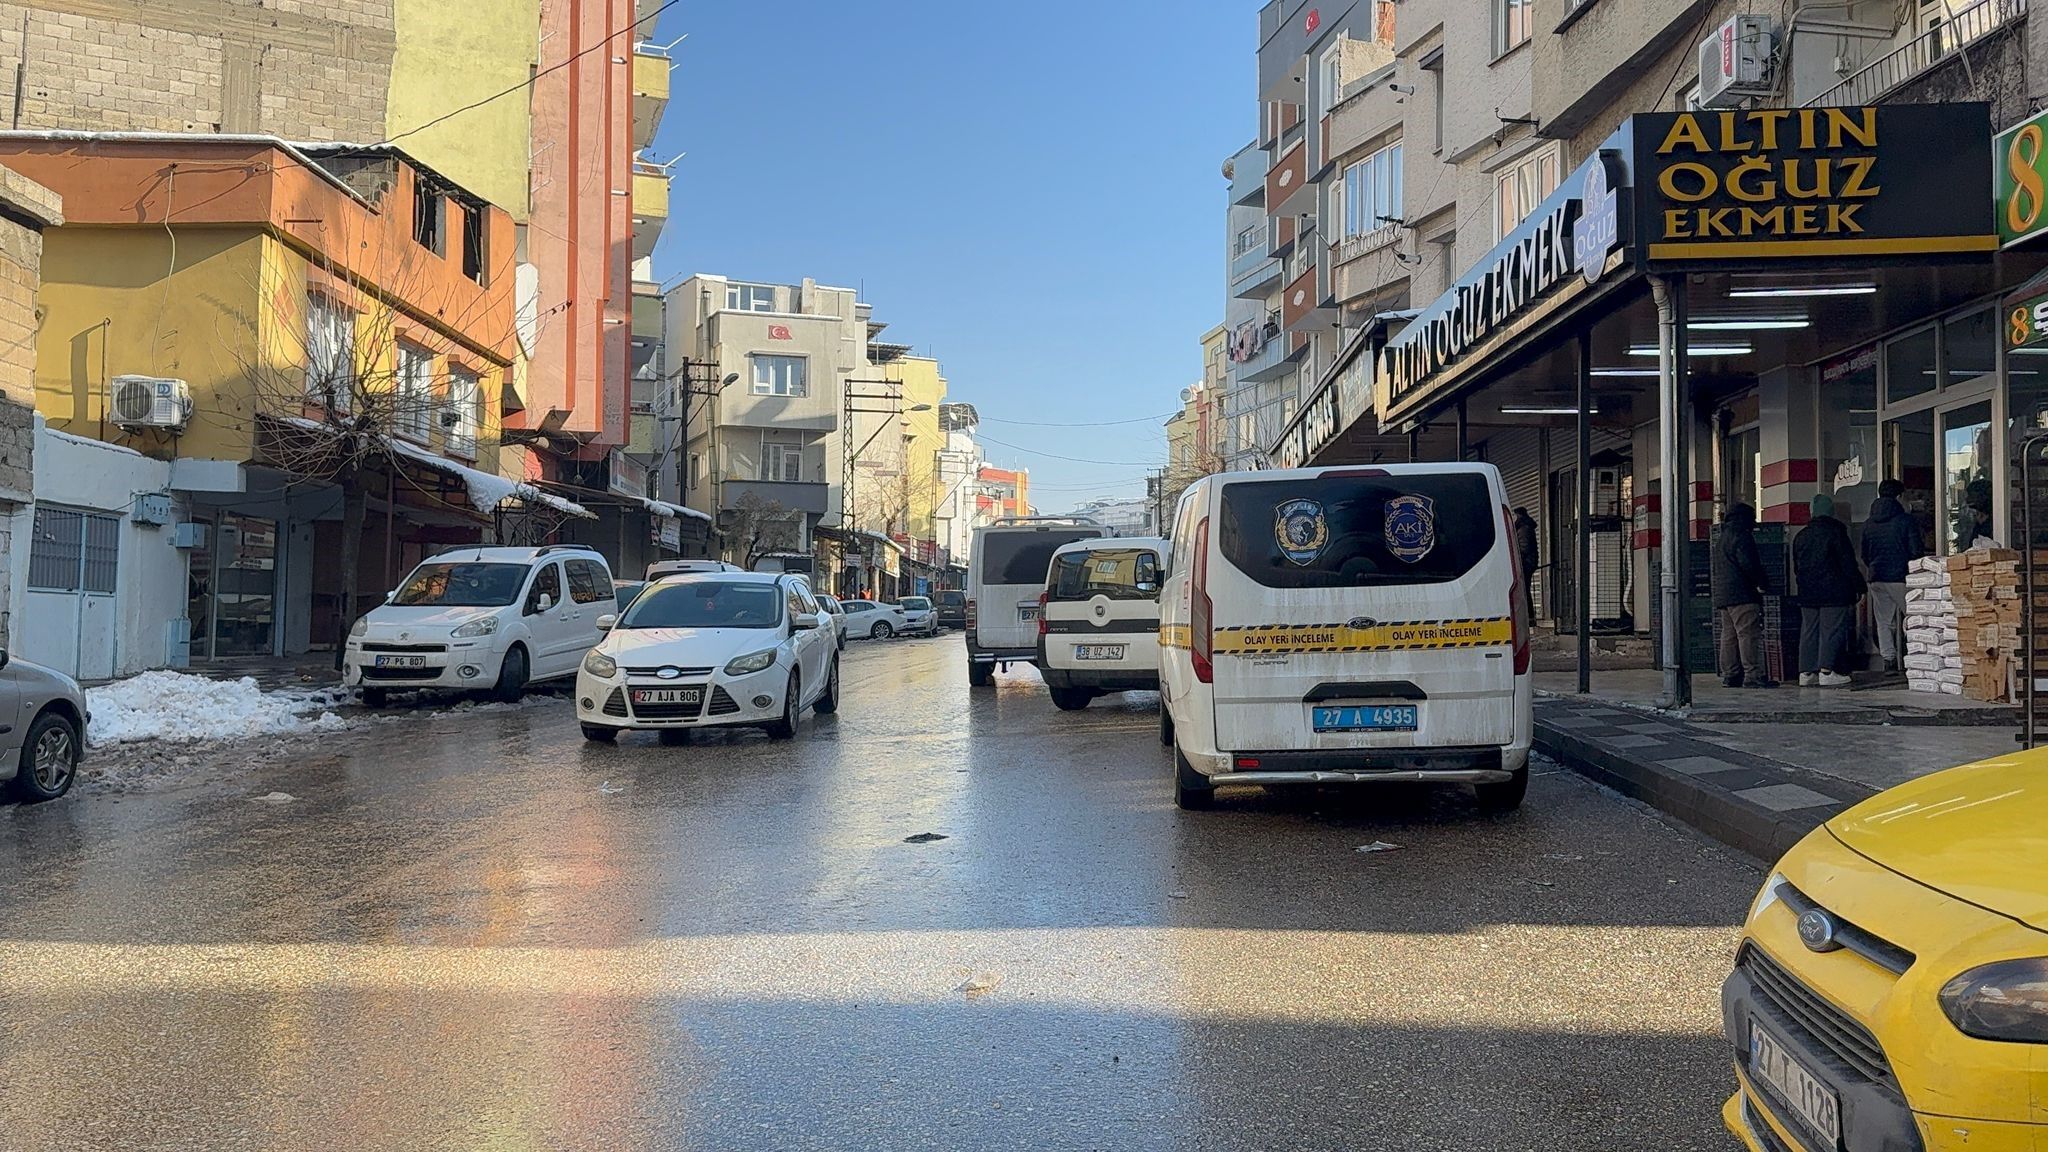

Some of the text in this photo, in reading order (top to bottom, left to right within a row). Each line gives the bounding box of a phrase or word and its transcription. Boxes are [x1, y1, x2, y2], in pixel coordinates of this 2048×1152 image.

[1655, 107, 1878, 154] ALTIN
[1658, 154, 1881, 202] OĞUZ
[2007, 124, 2045, 233] 8
[1575, 211, 1616, 260] OĞUZ
[1662, 203, 1865, 238] EKMEK
[1392, 325, 1431, 399] ALTIN
[1435, 275, 1487, 367] OĞUZ
[1491, 199, 1569, 328] EKMEK
[1305, 384, 1335, 456] GROSS
[1394, 520, 1423, 534] AKİ
[1244, 635, 1267, 645] OLAY
[1392, 629, 1416, 641] OLAY
[380, 657, 424, 666] 27 PG 807
[1081, 647, 1120, 656] 38 UZ 142
[641, 691, 698, 702] 27 AJA 806
[1323, 708, 1413, 726] 27 A 4935
[1800, 914, 1820, 939] Ford
[1757, 1031, 1835, 1140] 27 T 1128
